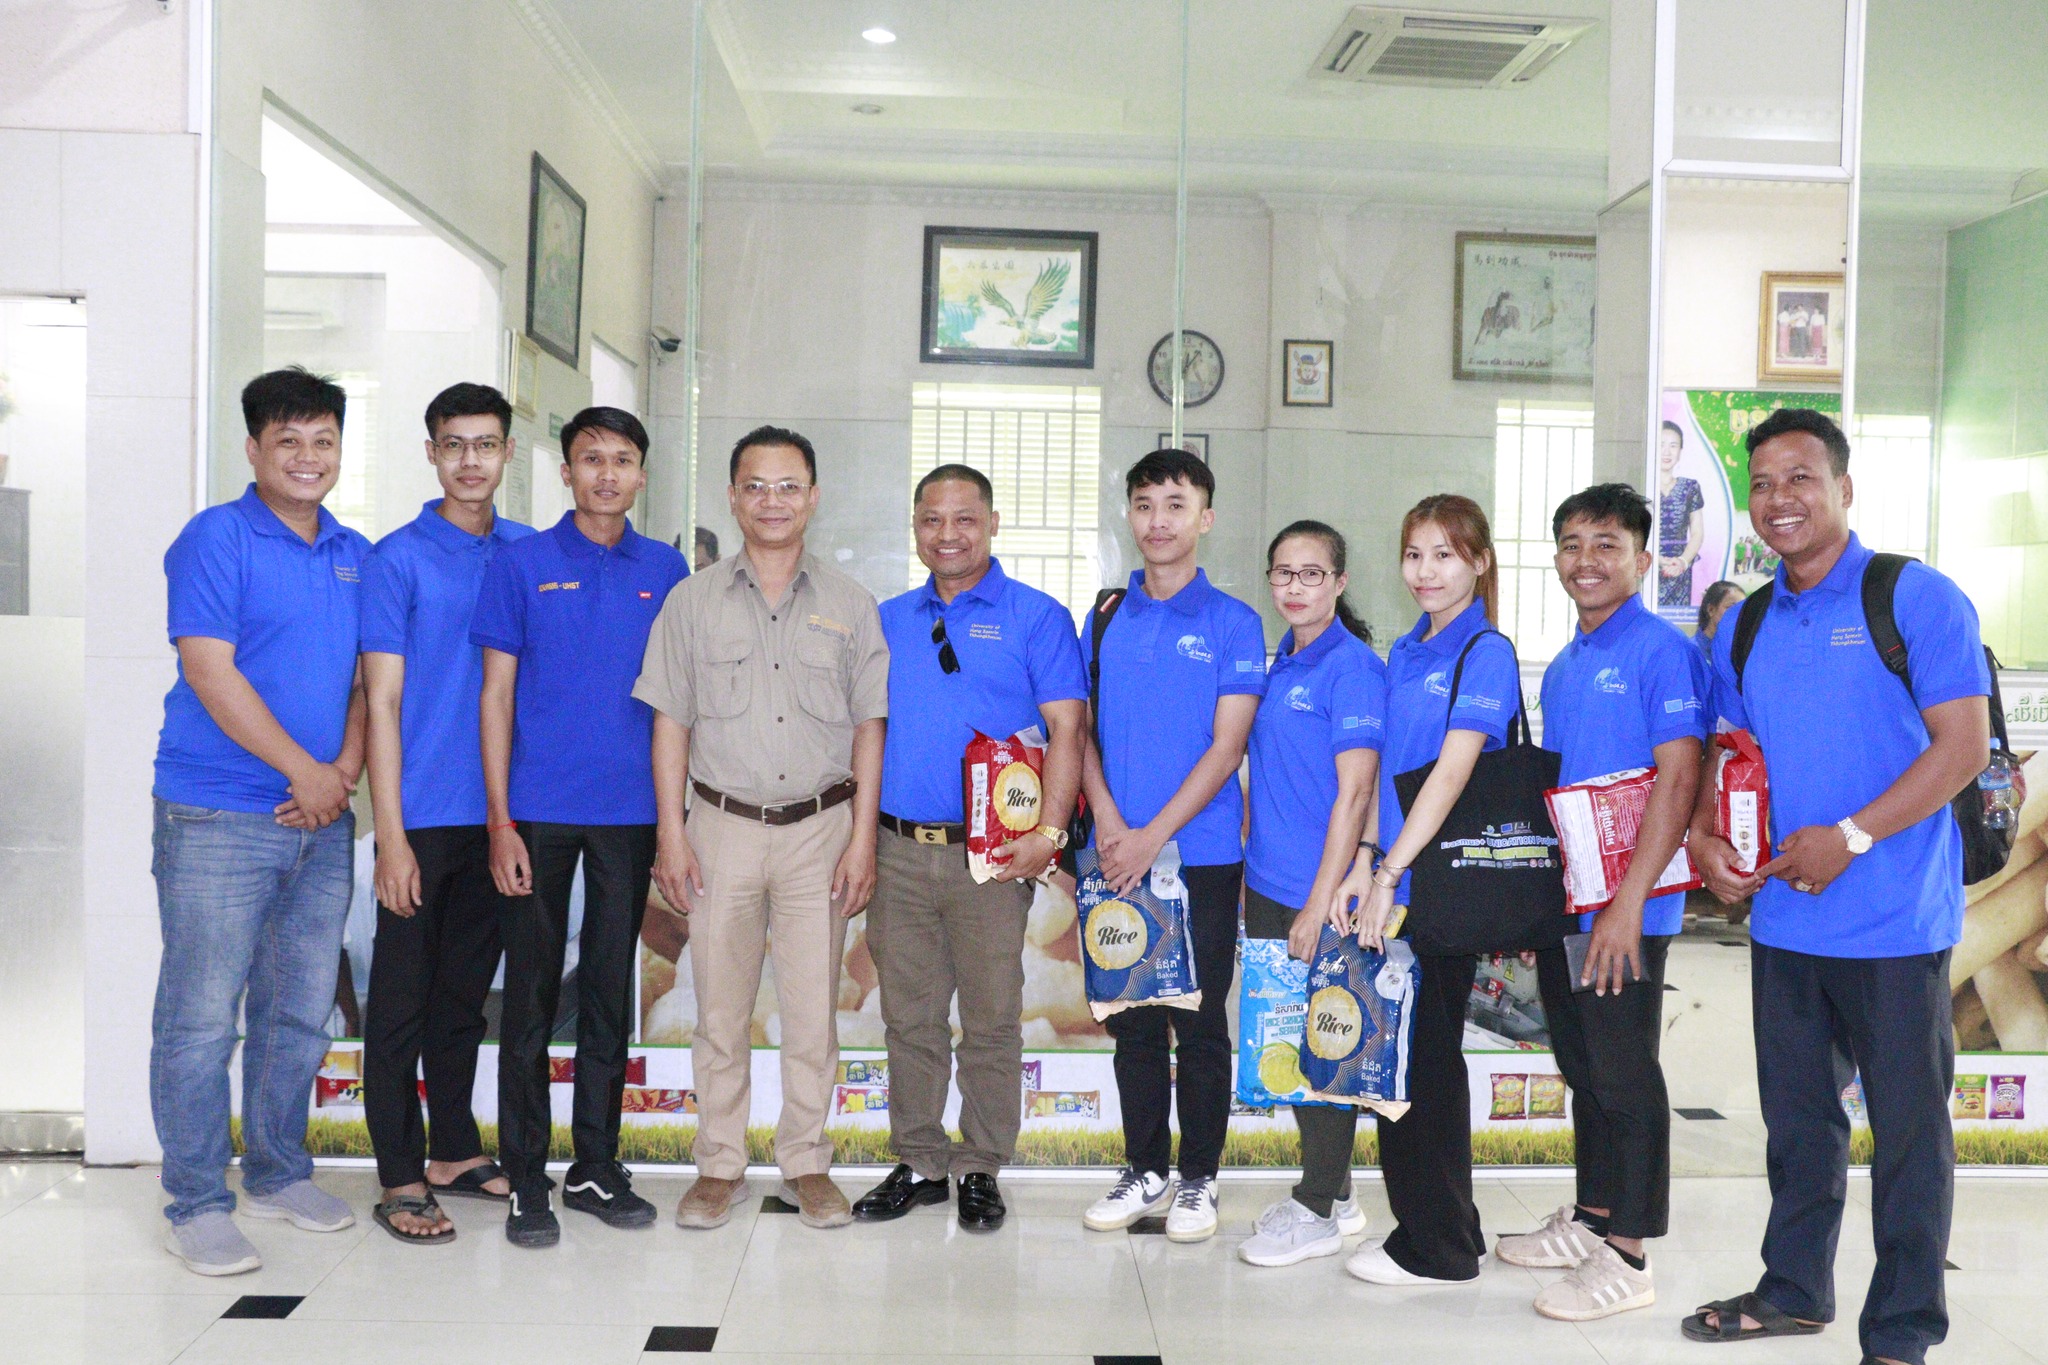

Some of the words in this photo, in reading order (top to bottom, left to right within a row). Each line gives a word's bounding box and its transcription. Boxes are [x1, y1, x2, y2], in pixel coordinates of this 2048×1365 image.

[1007, 787, 1038, 808] Rice
[1536, 836, 1559, 847] Projec
[1097, 926, 1138, 946] Rice
[1156, 970, 1179, 980] Baked
[1316, 1012, 1354, 1036] Rice
[1361, 1072, 1381, 1083] Baked
